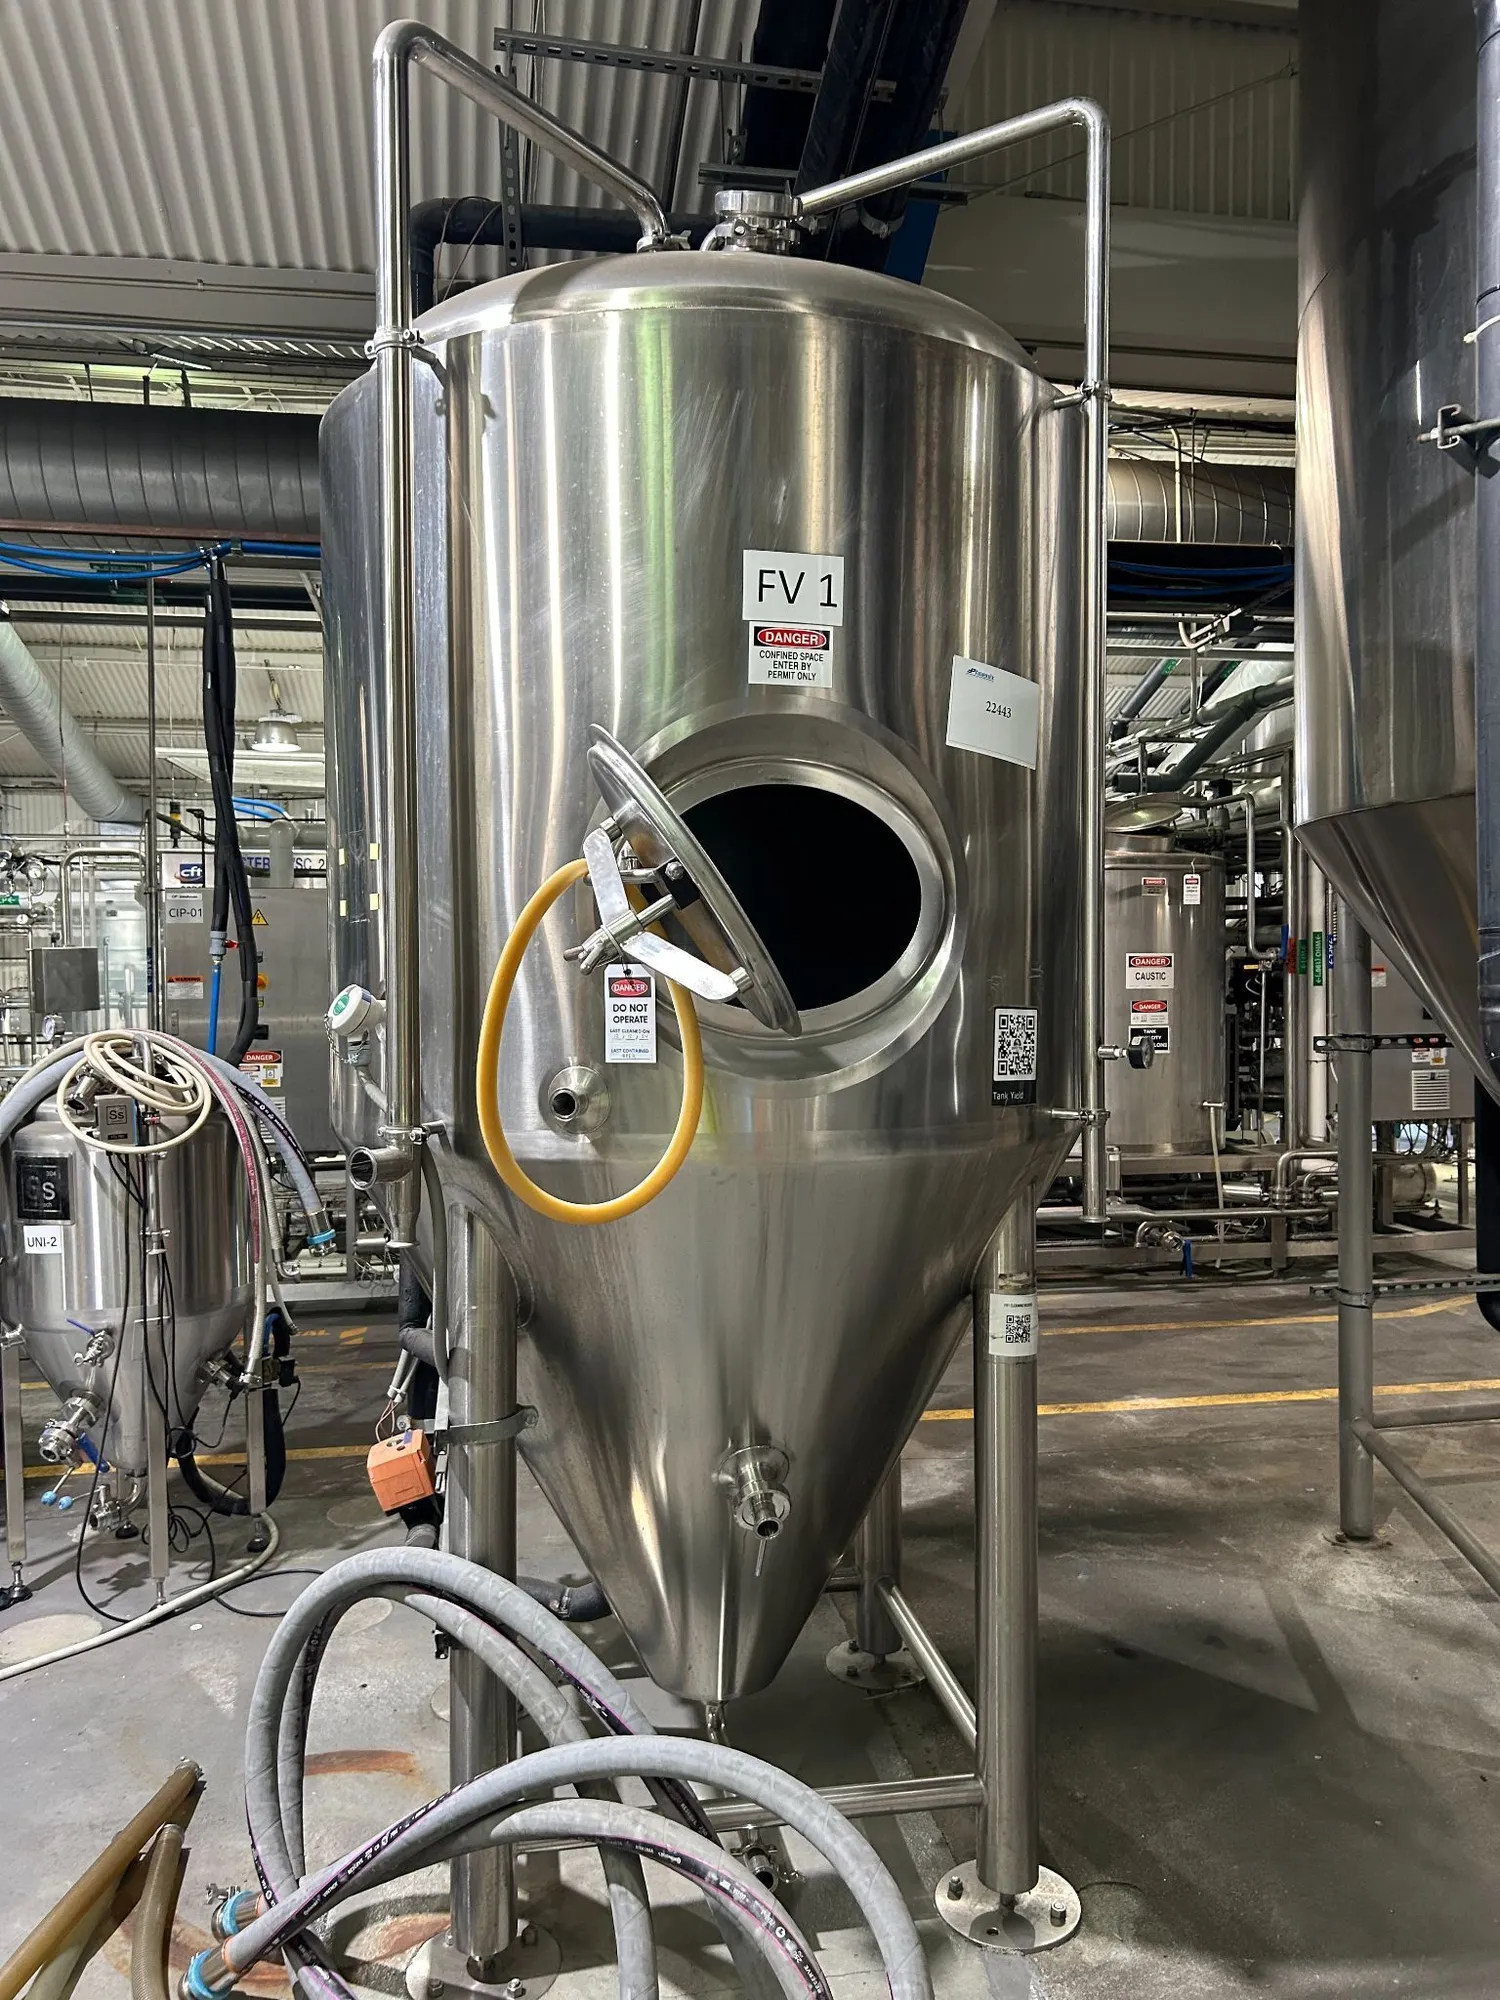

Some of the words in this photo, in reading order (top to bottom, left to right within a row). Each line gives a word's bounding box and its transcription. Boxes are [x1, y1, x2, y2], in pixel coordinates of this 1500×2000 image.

[759, 569, 805, 604] FV
[820, 574, 837, 607] 1
[765, 631, 818, 645] DANGER
[759, 650, 799, 660] CONFINED
[799, 651, 824, 662] SPACE
[773, 661, 799, 670] ENTER
[801, 662, 812, 671] BY
[767, 670, 795, 680] PERMIT
[797, 671, 817, 681] ONLY
[985, 700, 1012, 719] 22443
[169, 907, 203, 918] CIP-01
[1135, 972, 1166, 981] CAUSTIC
[613, 1004, 627, 1012] DO
[629, 1004, 648, 1012] NOT
[613, 1015, 648, 1023] OPERATE
[993, 1091, 1008, 1100] Tank
[1010, 1091, 1024, 1100] Yield
[109, 1110, 124, 1120] Ss
[27, 1236, 57, 1248] UNI-2
